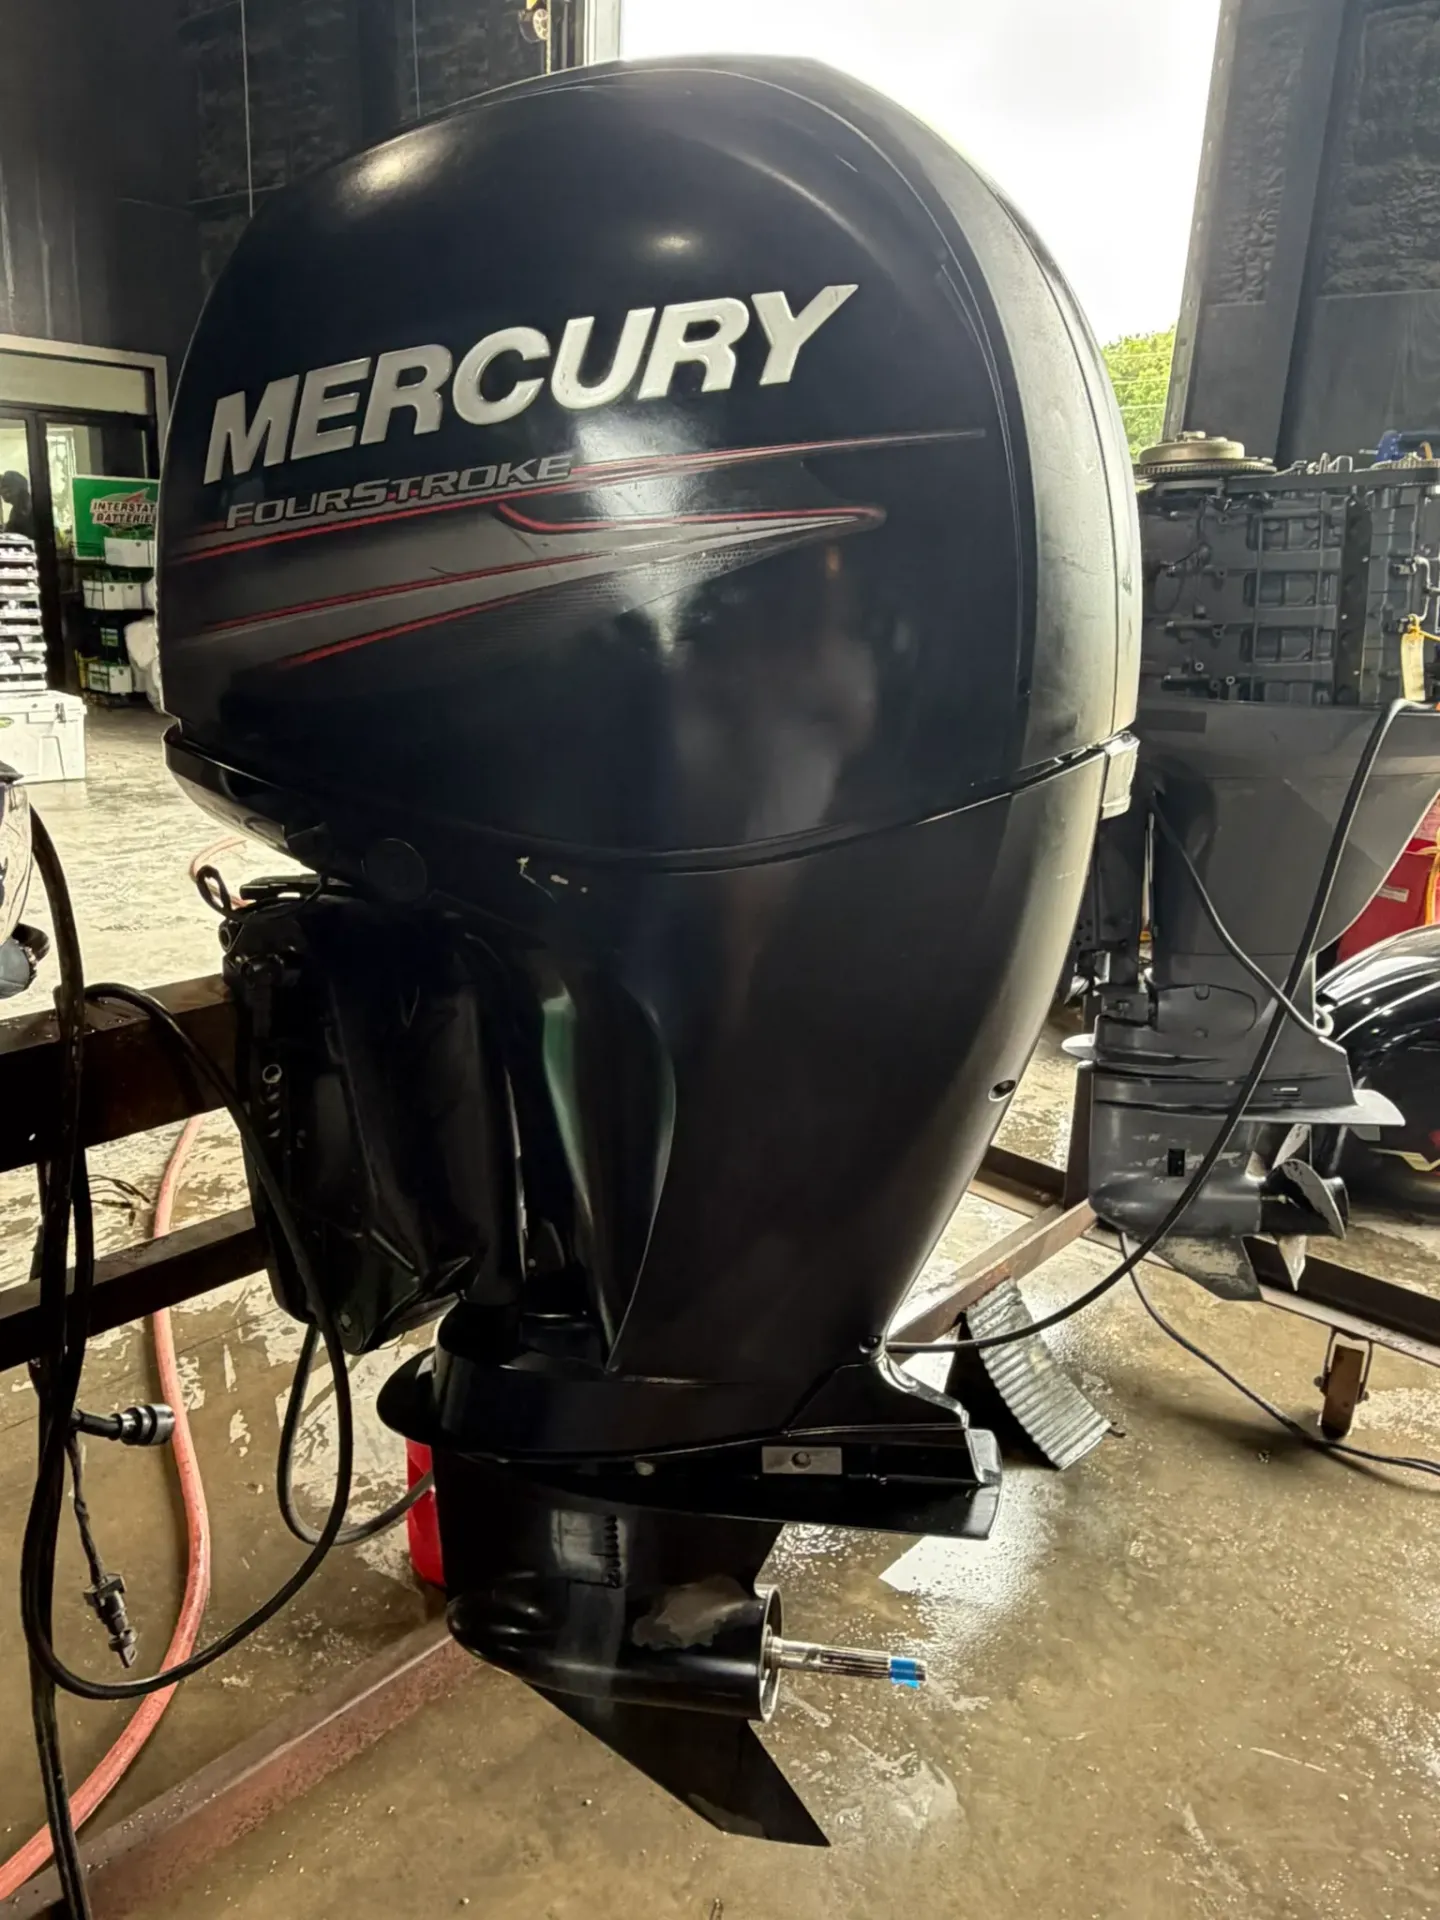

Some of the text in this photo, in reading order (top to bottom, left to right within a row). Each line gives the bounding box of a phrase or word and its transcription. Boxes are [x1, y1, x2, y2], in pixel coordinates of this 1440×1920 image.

[203, 284, 858, 486] MERCURY
[93, 502, 156, 514] INTERSTAT
[226, 453, 575, 530] FOURSTROKE
